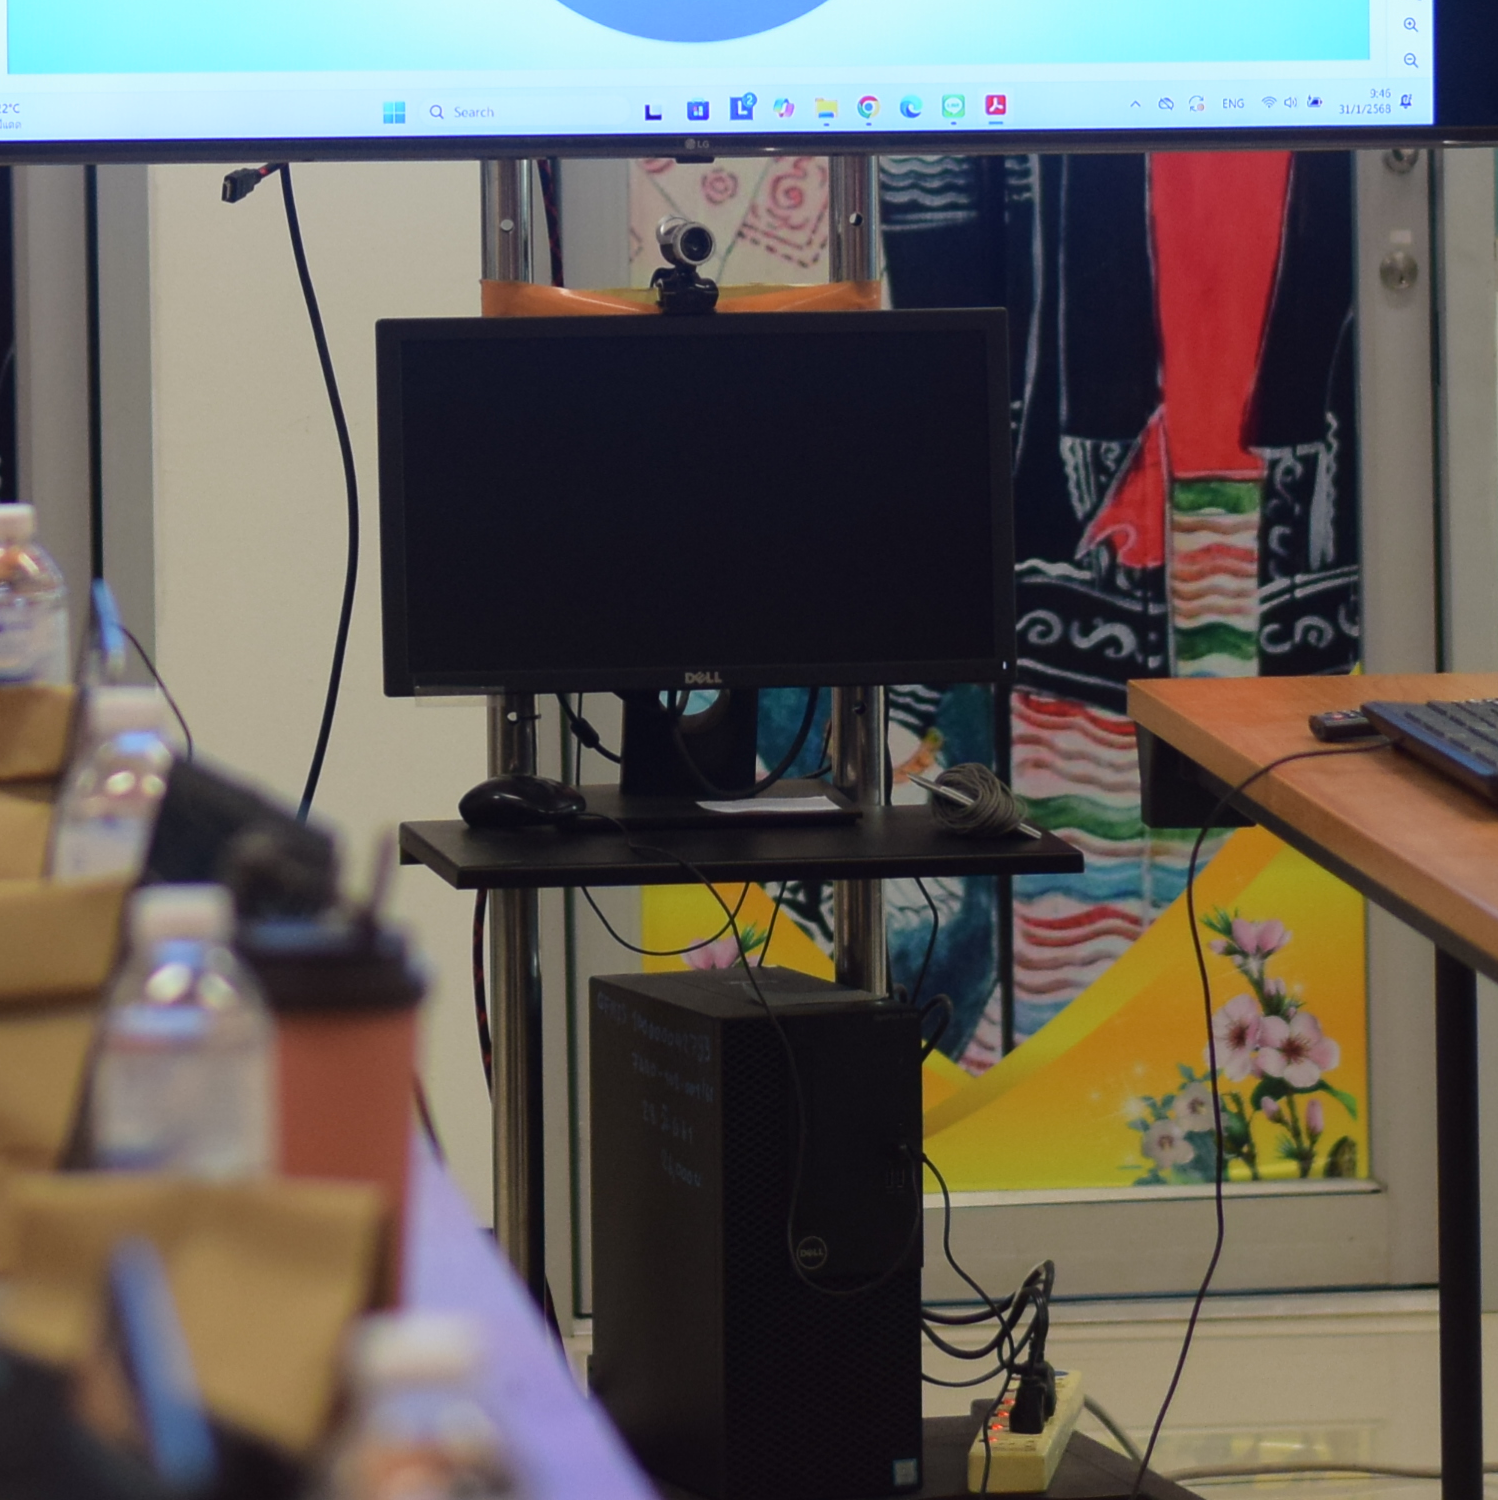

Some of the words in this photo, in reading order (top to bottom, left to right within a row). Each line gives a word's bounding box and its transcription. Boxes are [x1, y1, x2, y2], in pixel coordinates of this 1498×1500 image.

[1370, 87, 1391, 98] 9:46
[1222, 97, 1244, 109] ENG
[1339, 103, 1391, 114] 31/1/2568
[453, 106, 494, 118] Search
[684, 671, 722, 684] DELL
